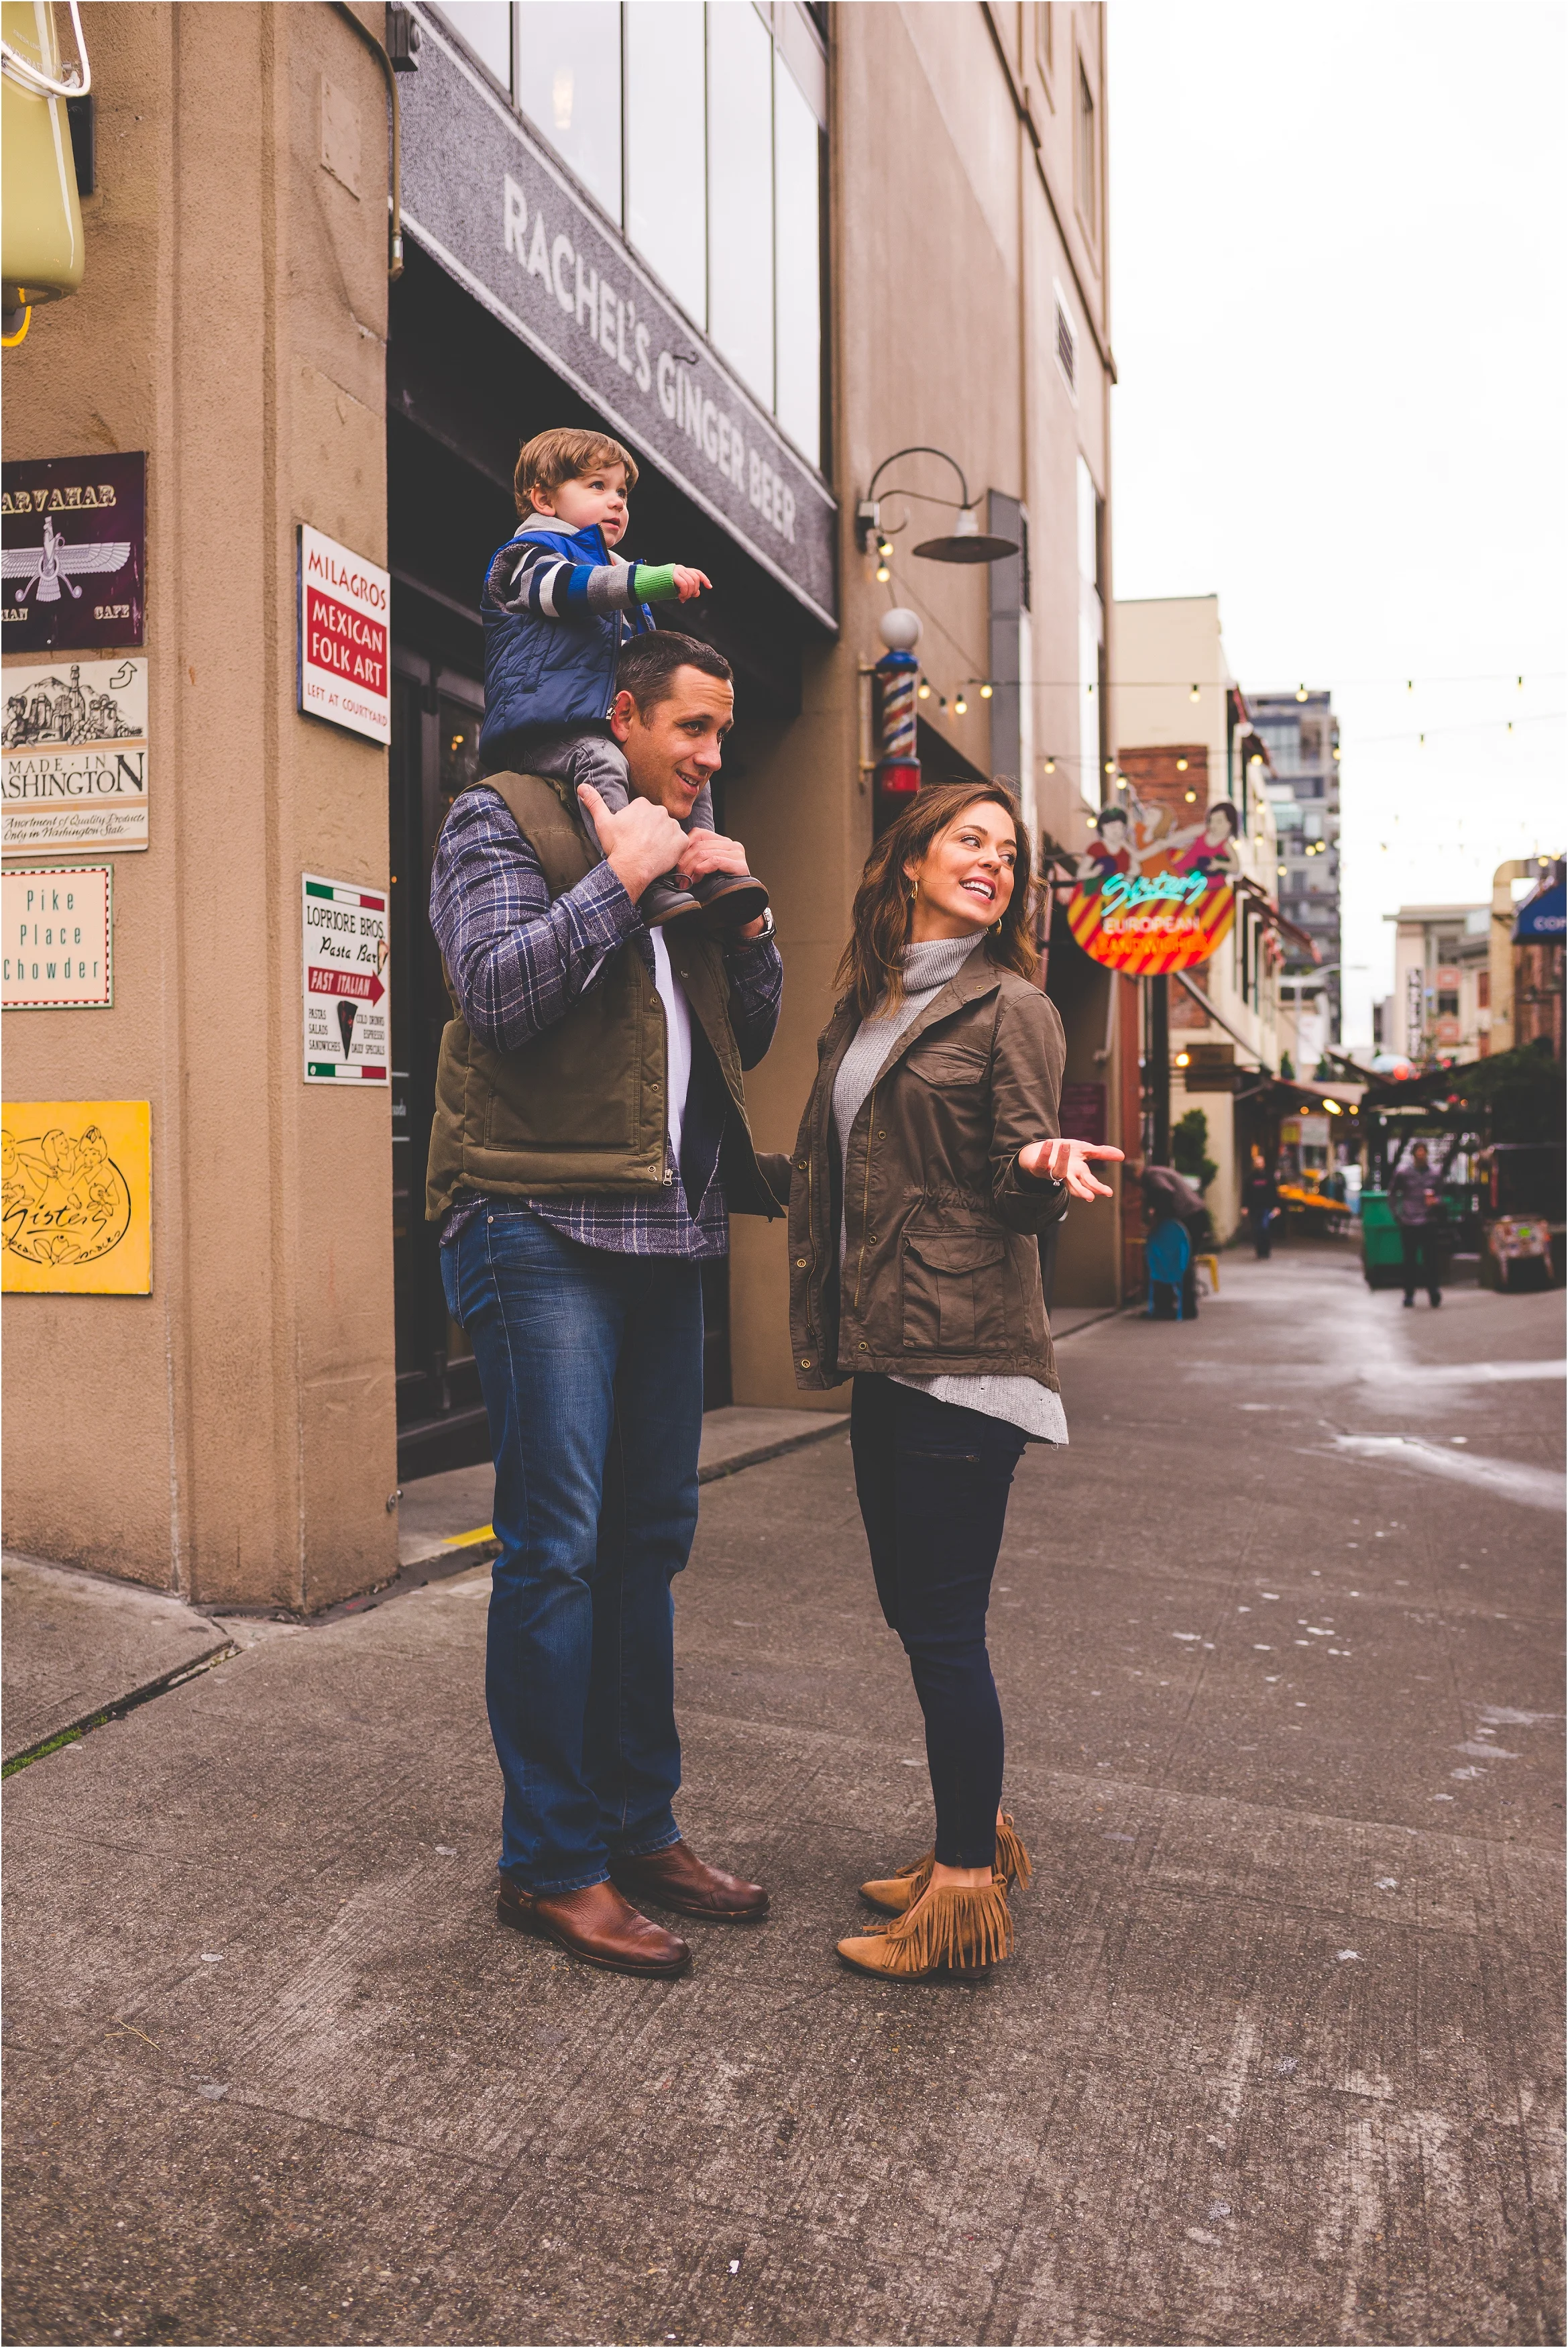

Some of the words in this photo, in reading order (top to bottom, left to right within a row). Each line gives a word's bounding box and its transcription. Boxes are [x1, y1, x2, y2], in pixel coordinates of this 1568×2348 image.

[504, 172, 651, 393] RACHEL'S
[657, 351, 745, 493] GINGER
[749, 448, 796, 544] BEER
[309, 548, 386, 611] MILAGROS
[94, 604, 130, 620] CAFE
[313, 600, 383, 653] MEXICAN
[313, 632, 350, 672] FOLK
[353, 655, 383, 687] ART
[307, 682, 325, 701] LEFT
[328, 693, 339, 707] AT
[342, 698, 388, 727] COURTYARD
[8, 757, 63, 774] MADE
[85, 755, 107, 770] IN
[58, 816, 69, 829] of
[70, 814, 105, 826] Quality
[107, 812, 145, 826] Products
[4, 829, 27, 844] Only
[29, 829, 40, 839] in
[42, 825, 99, 839] Washington
[101, 824, 130, 837] State
[27, 889, 74, 911] Pike
[307, 906, 356, 933] LOPRIORE
[360, 917, 386, 939] BROS.
[1102, 916, 1200, 935] EUROPEAN
[20, 924, 81, 946] Place
[320, 937, 351, 959] Pasta
[357, 944, 377, 963] Bar
[4, 957, 99, 980] Chowder
[311, 970, 334, 992] FAST
[337, 974, 371, 997] ITALIAN
